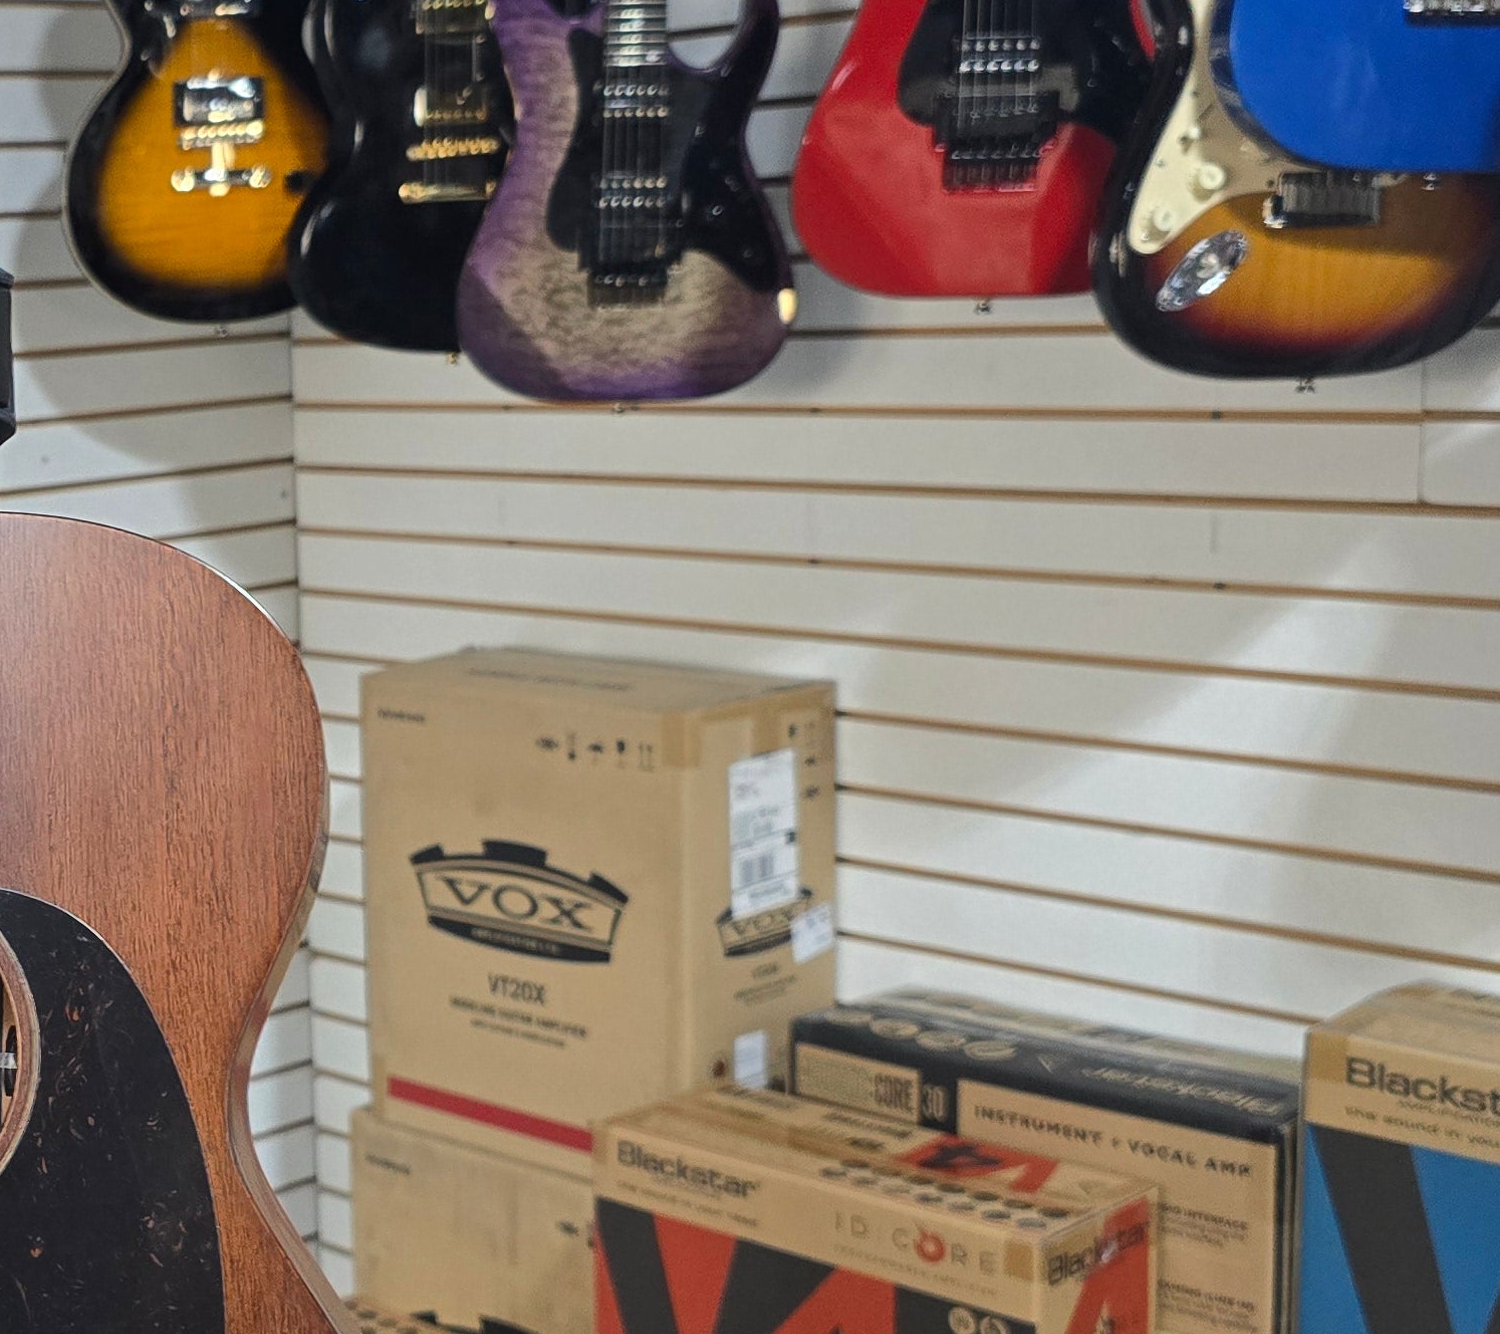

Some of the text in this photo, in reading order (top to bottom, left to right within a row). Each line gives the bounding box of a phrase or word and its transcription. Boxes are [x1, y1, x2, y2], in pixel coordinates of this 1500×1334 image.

[436, 875, 592, 932] VOX
[487, 972, 547, 1006] VT20X
[921, 1082, 948, 1122] 30
[974, 1104, 1103, 1147] INSTRUMENT
[1127, 1138, 1198, 1168] VOCAL
[617, 1139, 761, 1198] Blackstar
